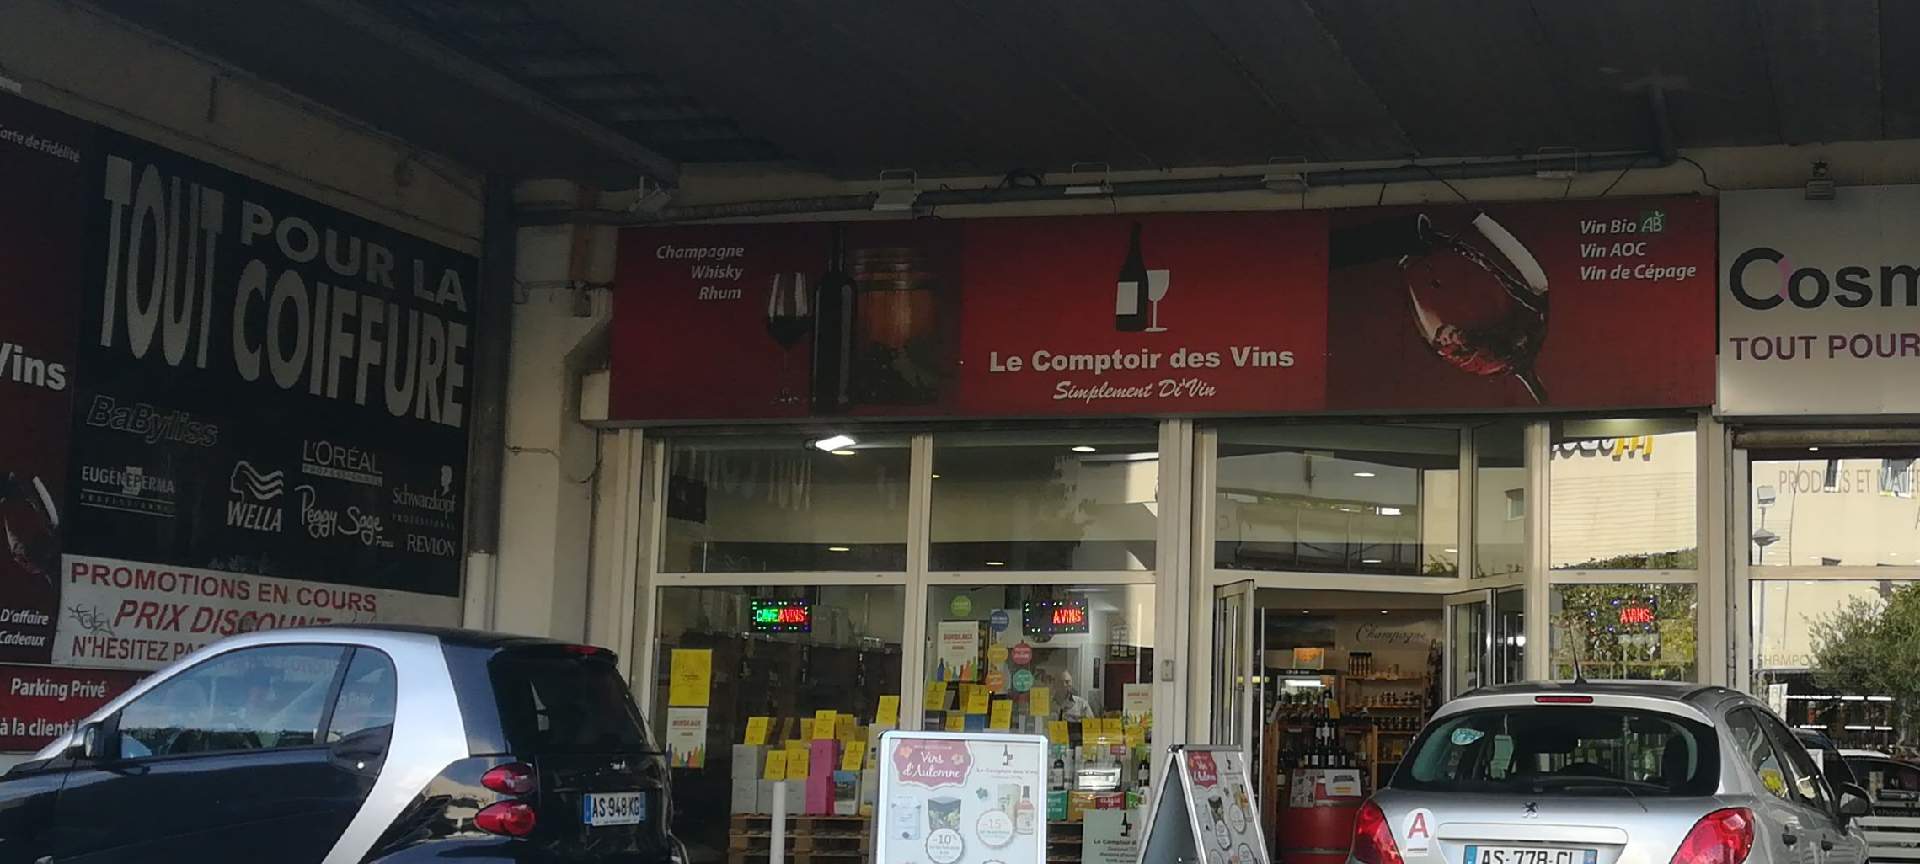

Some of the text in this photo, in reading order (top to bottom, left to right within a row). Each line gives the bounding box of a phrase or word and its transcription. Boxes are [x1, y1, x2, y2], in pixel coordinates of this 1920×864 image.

[24, 134, 40, 149] de
[1580, 220, 1606, 235] Vin
[1610, 219, 1636, 234] Bio
[100, 154, 224, 368] TOUT
[240, 200, 467, 313] POUR LA
[656, 245, 745, 263] Champagne
[1580, 242, 1647, 258] Vin AOC
[690, 264, 744, 281] Whisky
[1580, 263, 1697, 283] Vin de Cépage
[698, 285, 742, 301] Rhum
[233, 258, 467, 428] COIFFURE
[1729, 333, 1920, 361] TOUT POUR
[990, 346, 1295, 377] Le Comptoir des Vins
[1053, 380, 1153, 403] Simplement
[86, 394, 218, 447] BaByliss
[302, 439, 383, 475] L'ORÉAL
[1857, 469, 1871, 493] ET
[392, 483, 457, 521] Schwarzkopf
[226, 500, 282, 533] WELLA
[294, 485, 384, 545] Peggy Sage
[407, 534, 456, 556] REVLON
[71, 562, 377, 613] PROMOTIONS EN COURS
[1, 608, 49, 625] D'affaire
[114, 599, 189, 633] PRIX
[72, 636, 169, 662] N'HESITEZ
[11, 677, 107, 702] Parking Privé
[0, 717, 8, 736] à
[12, 717, 26, 736] la
[902, 762, 961, 778] d'Automne
[921, 751, 944, 764] Vins
[1408, 812, 1428, 838] A
